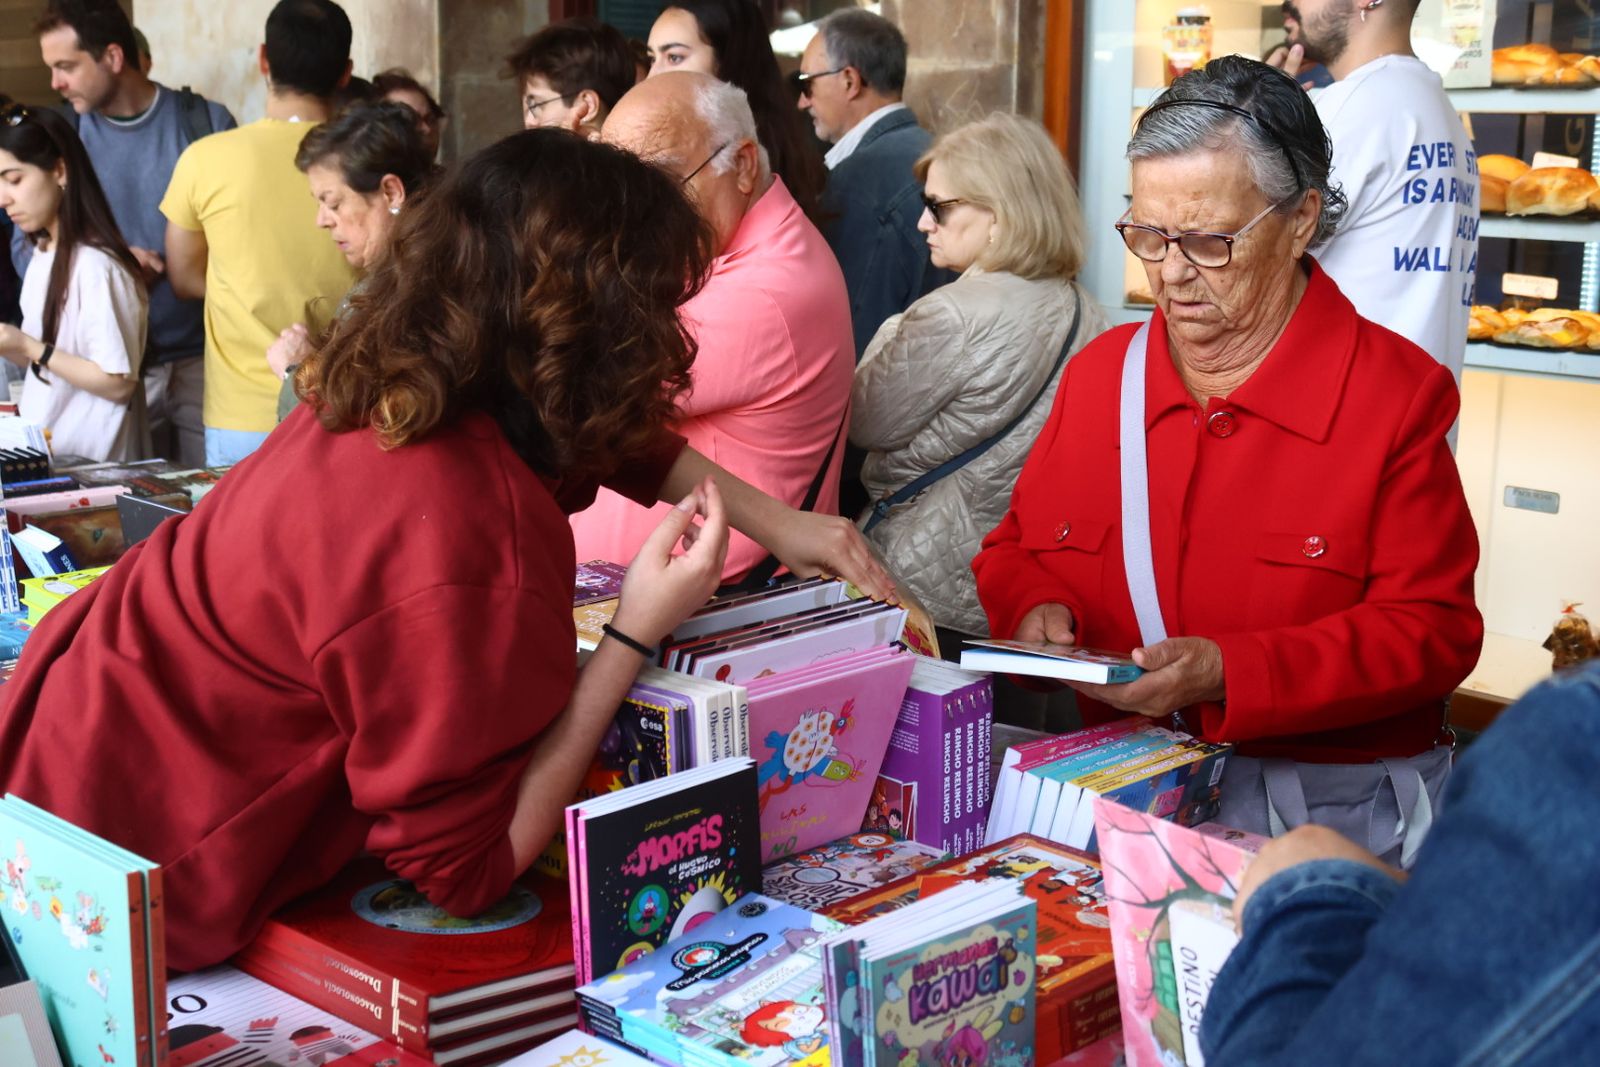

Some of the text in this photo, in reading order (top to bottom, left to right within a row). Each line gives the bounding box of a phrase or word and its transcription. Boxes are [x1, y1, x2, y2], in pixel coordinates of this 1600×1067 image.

[1406, 142, 1456, 171] EVER
[1402, 178, 1427, 204] IS
[1430, 178, 1445, 203] A
[1393, 247, 1452, 272] WAL
[954, 727, 962, 819] RANCHO RELINCHO
[966, 722, 974, 813] RANCHO RELINCHO
[943, 777, 951, 824] RELINCHO
